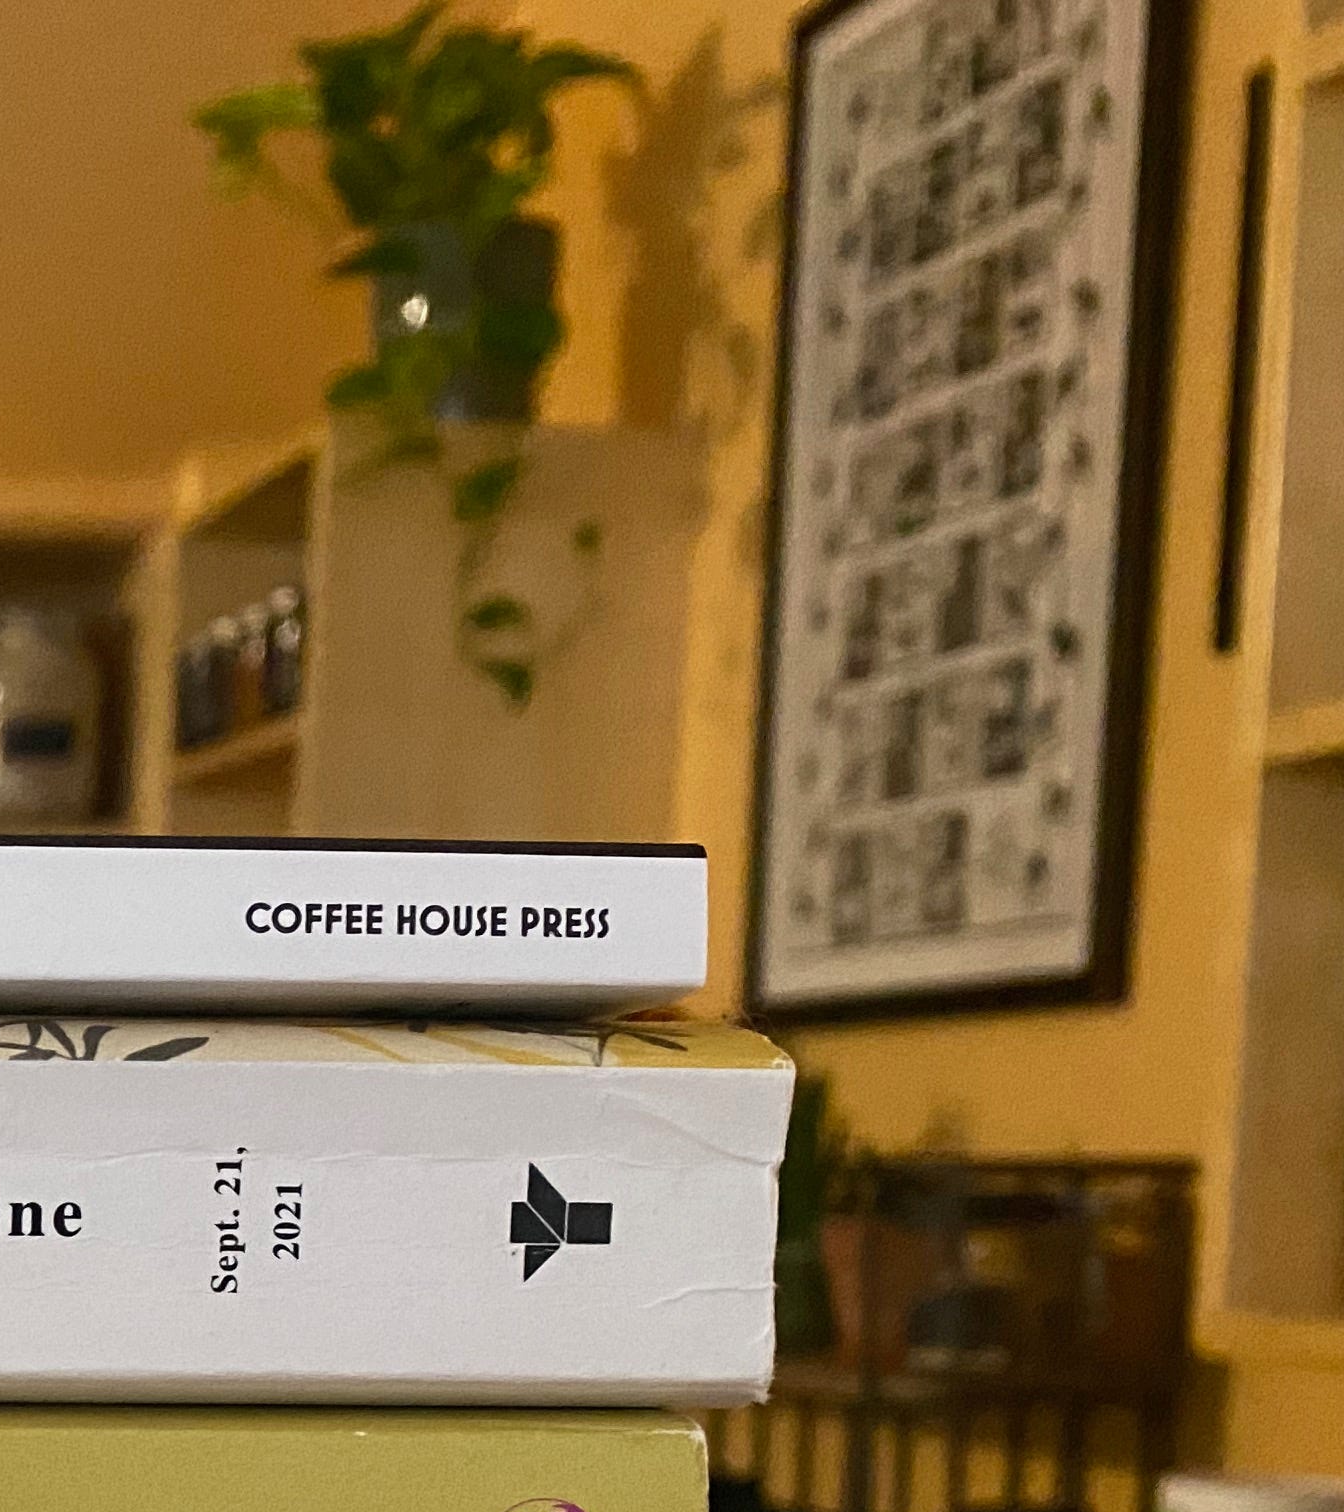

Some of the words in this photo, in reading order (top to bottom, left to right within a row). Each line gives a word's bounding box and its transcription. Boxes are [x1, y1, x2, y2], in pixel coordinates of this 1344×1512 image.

[245, 902, 384, 935] COFFEE
[396, 904, 508, 937] HOUSE
[521, 906, 610, 939] PRESS
[213, 1146, 248, 1196] 21,
[210, 1209, 247, 1294] Sept.
[272, 1183, 303, 1260] 2021
